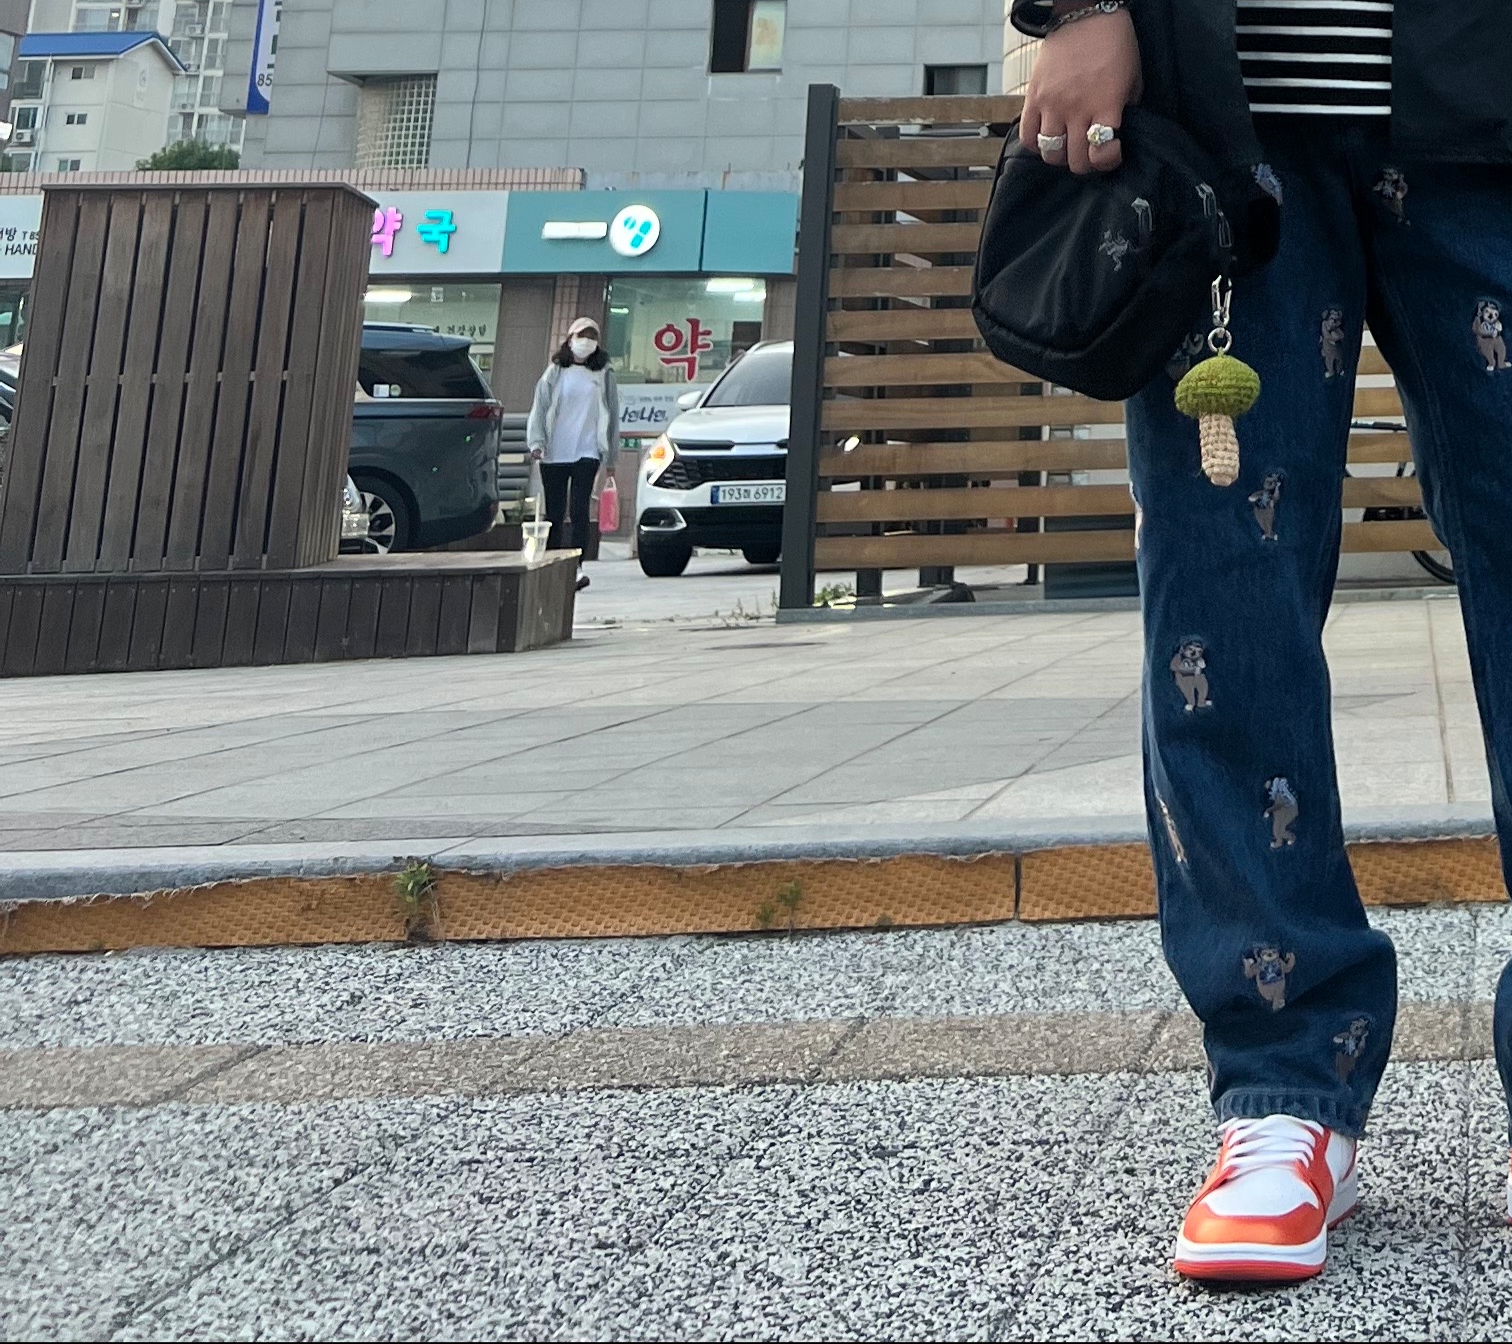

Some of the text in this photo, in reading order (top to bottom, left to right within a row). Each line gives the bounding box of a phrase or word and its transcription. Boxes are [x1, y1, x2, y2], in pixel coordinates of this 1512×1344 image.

[257, 73, 273, 87] 85
[653, 317, 713, 383] 약
[753, 486, 783, 500] 6912
